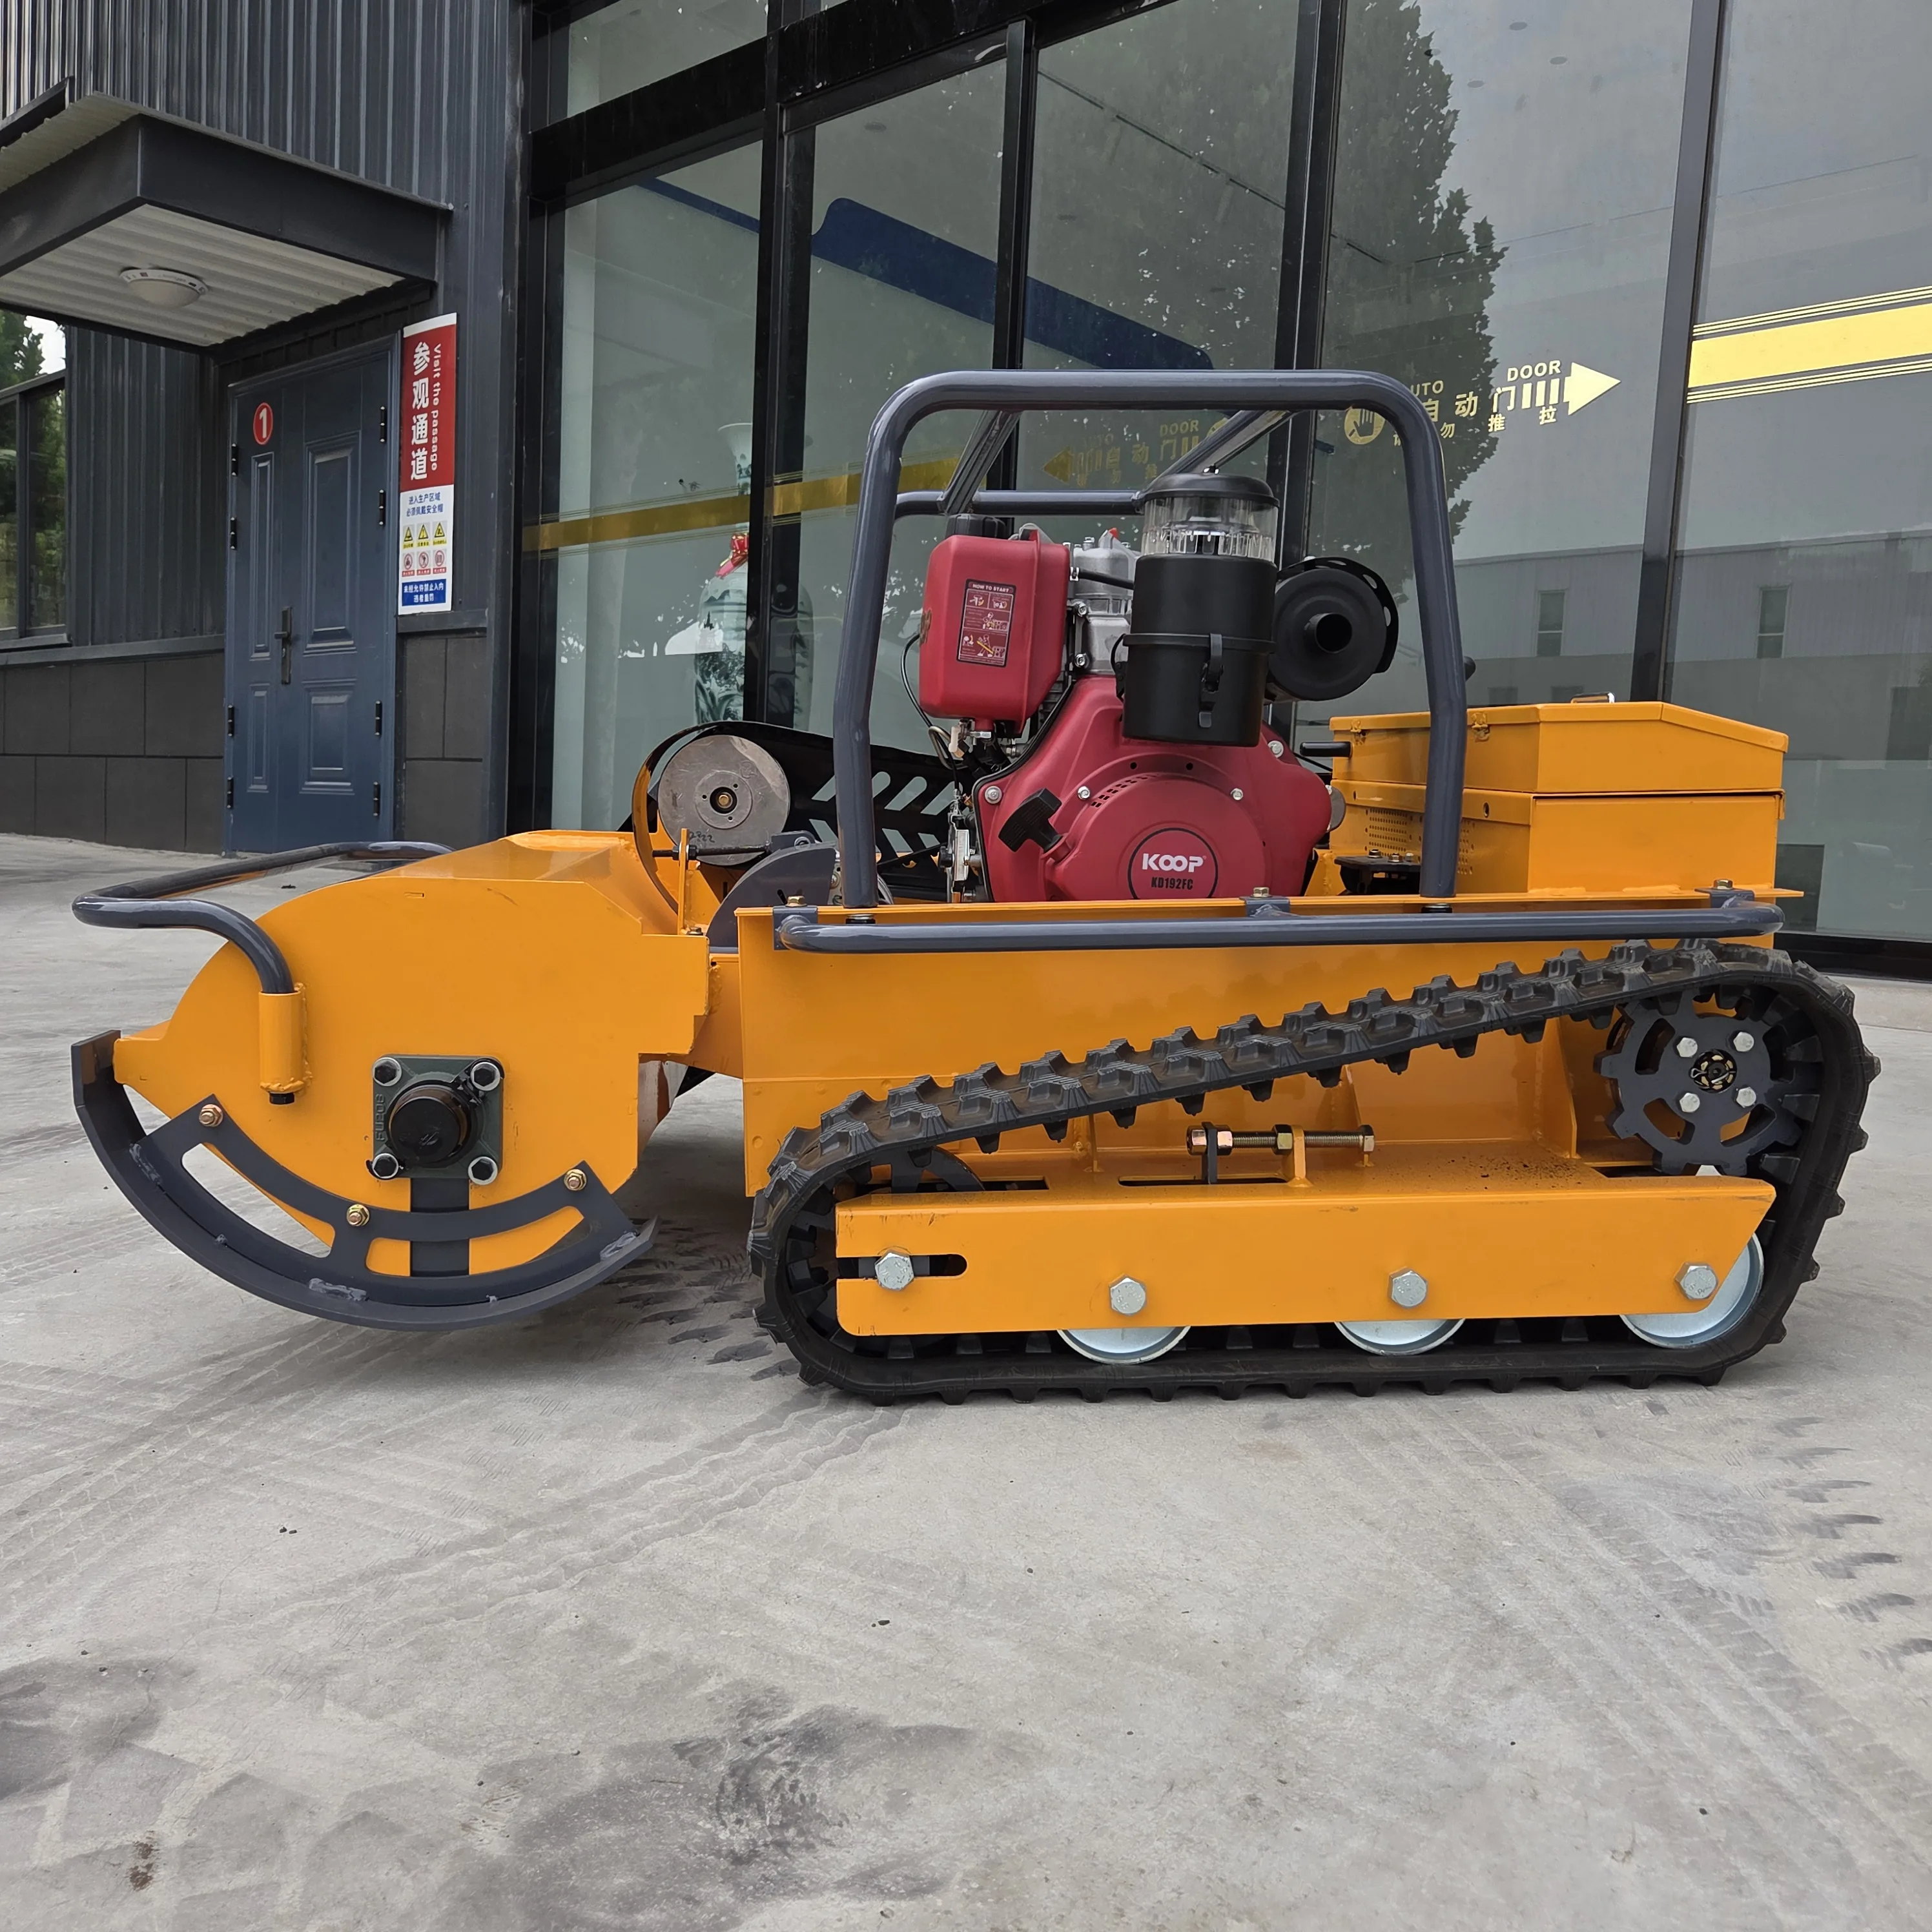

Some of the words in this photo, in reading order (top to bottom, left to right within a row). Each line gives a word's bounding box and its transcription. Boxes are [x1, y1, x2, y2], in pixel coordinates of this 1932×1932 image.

[433, 344, 442, 379] Visit
[1410, 380, 1444, 396] UTO
[1507, 360, 1561, 382] DOOR
[433, 384, 442, 406] the
[411, 342, 430, 480] 参观通道
[430, 409, 439, 471] passage
[1160, 419, 1199, 437] DOOR
[1142, 853, 1204, 873] KOOP
[1151, 876, 1193, 890] KD192FC
